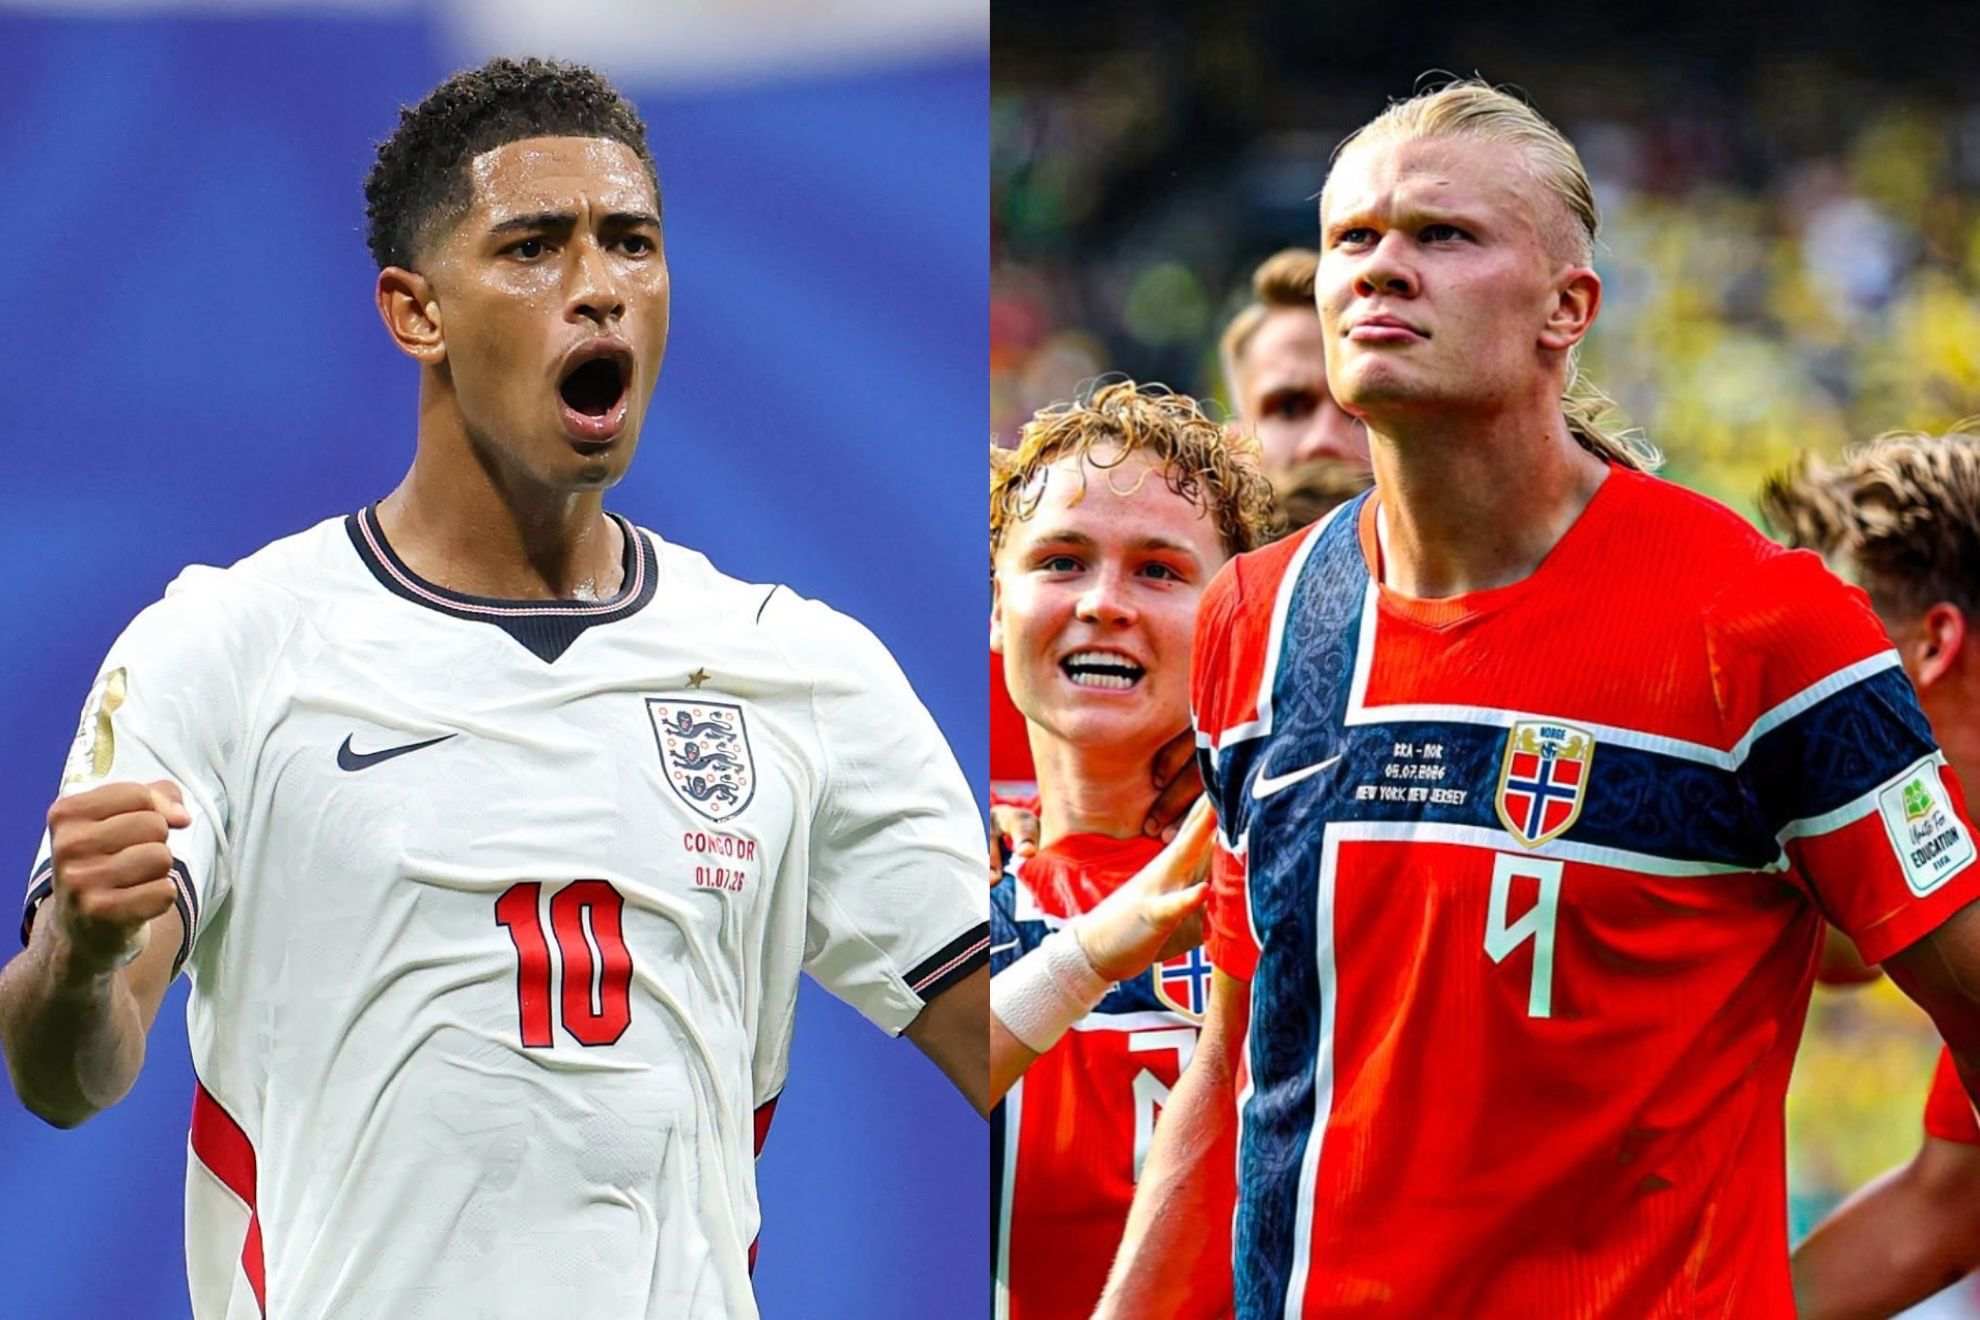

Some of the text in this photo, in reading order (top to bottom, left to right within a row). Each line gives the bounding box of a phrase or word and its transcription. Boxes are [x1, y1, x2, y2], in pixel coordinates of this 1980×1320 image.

[1540, 726, 1566, 740] NORGE
[1423, 743, 1443, 759] NOR
[1384, 763, 1446, 780] 05.07.2026
[1355, 785, 1468, 805] NEW YORK NEW JERSEY
[737, 839, 755, 861] DR
[1910, 825, 1960, 868] EDUCATION
[1932, 855, 1951, 871] FIFA
[695, 866, 746, 892] 01.07.26
[1483, 851, 1565, 1019] 9
[494, 879, 633, 1048] 10
